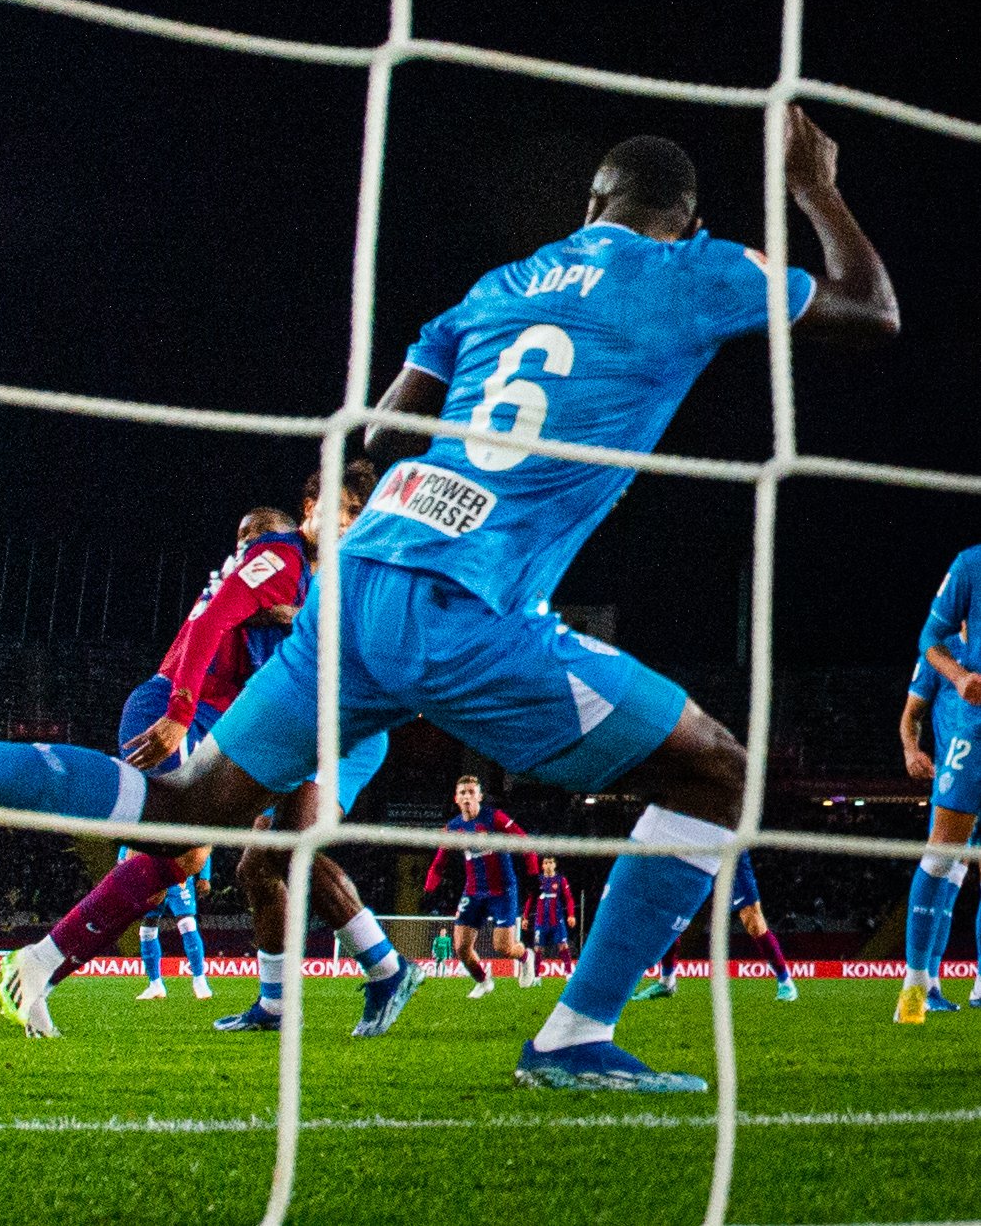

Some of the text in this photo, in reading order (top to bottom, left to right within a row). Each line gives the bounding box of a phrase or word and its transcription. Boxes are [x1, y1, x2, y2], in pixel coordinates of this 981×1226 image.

[524, 264, 606, 298] LOPY
[465, 323, 575, 471] 6
[407, 492, 476, 534] HORSE
[422, 473, 488, 516] POWER
[944, 736, 971, 770] 12
[738, 963, 816, 978] KONMI
[842, 963, 907, 978] KONAM
